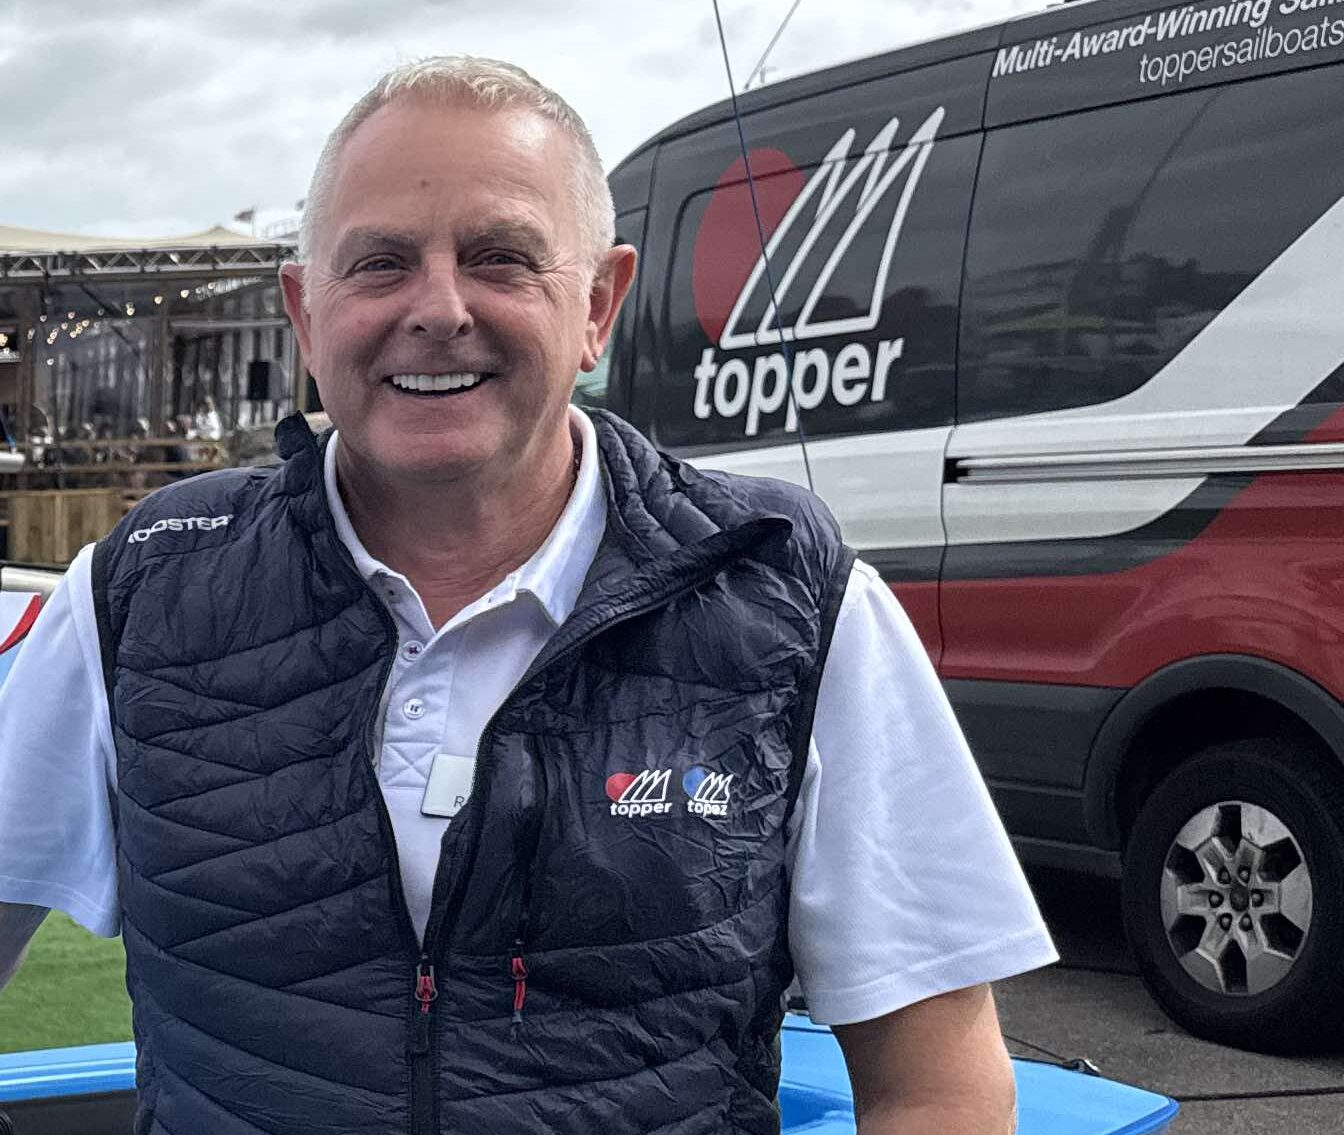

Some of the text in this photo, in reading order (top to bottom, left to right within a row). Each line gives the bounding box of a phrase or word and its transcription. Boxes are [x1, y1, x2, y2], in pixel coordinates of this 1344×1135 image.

[992, 0, 1270, 78] Multi-Award-Winning
[693, 338, 906, 436] topper
[610, 802, 672, 818] topper
[687, 800, 727, 818] topaz
